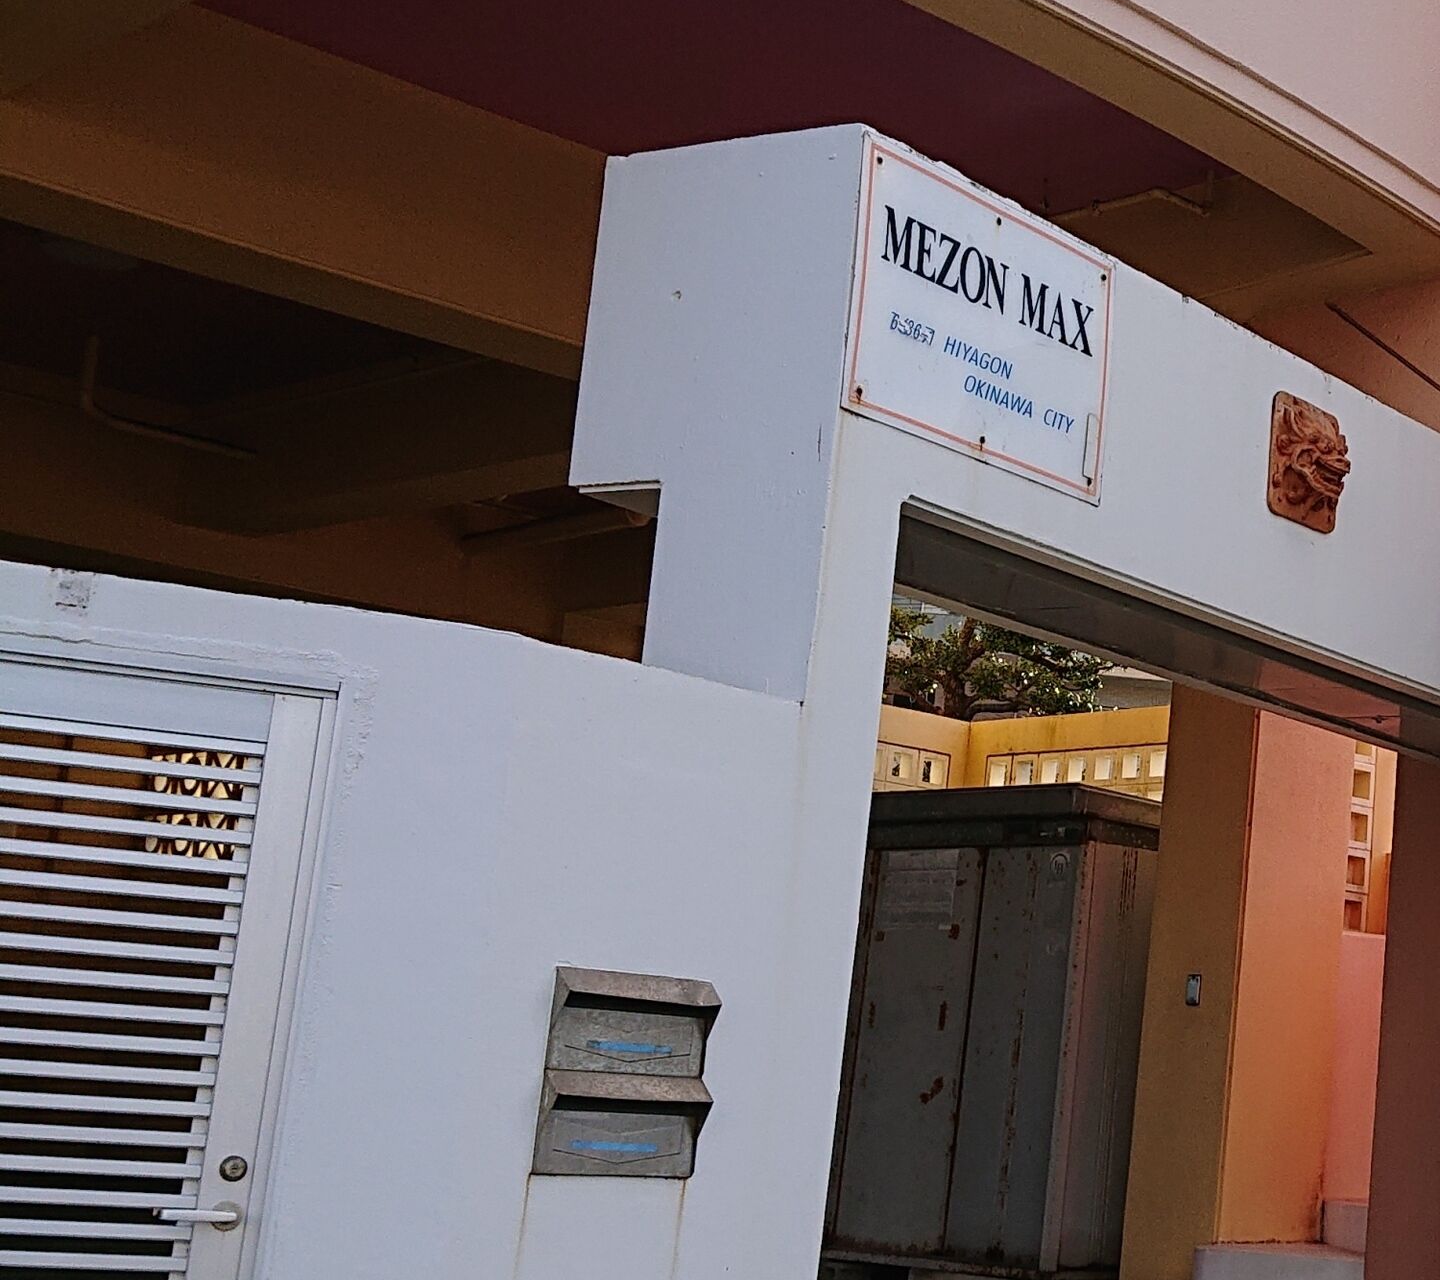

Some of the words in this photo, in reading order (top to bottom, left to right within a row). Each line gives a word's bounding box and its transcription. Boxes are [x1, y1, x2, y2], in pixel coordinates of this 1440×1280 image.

[881, 204, 1010, 315] MEZON
[1018, 272, 1095, 357] MAX
[943, 336, 1014, 380] HIYAGON
[963, 375, 1034, 419] OKINAWA
[1043, 408, 1075, 434] CITY
